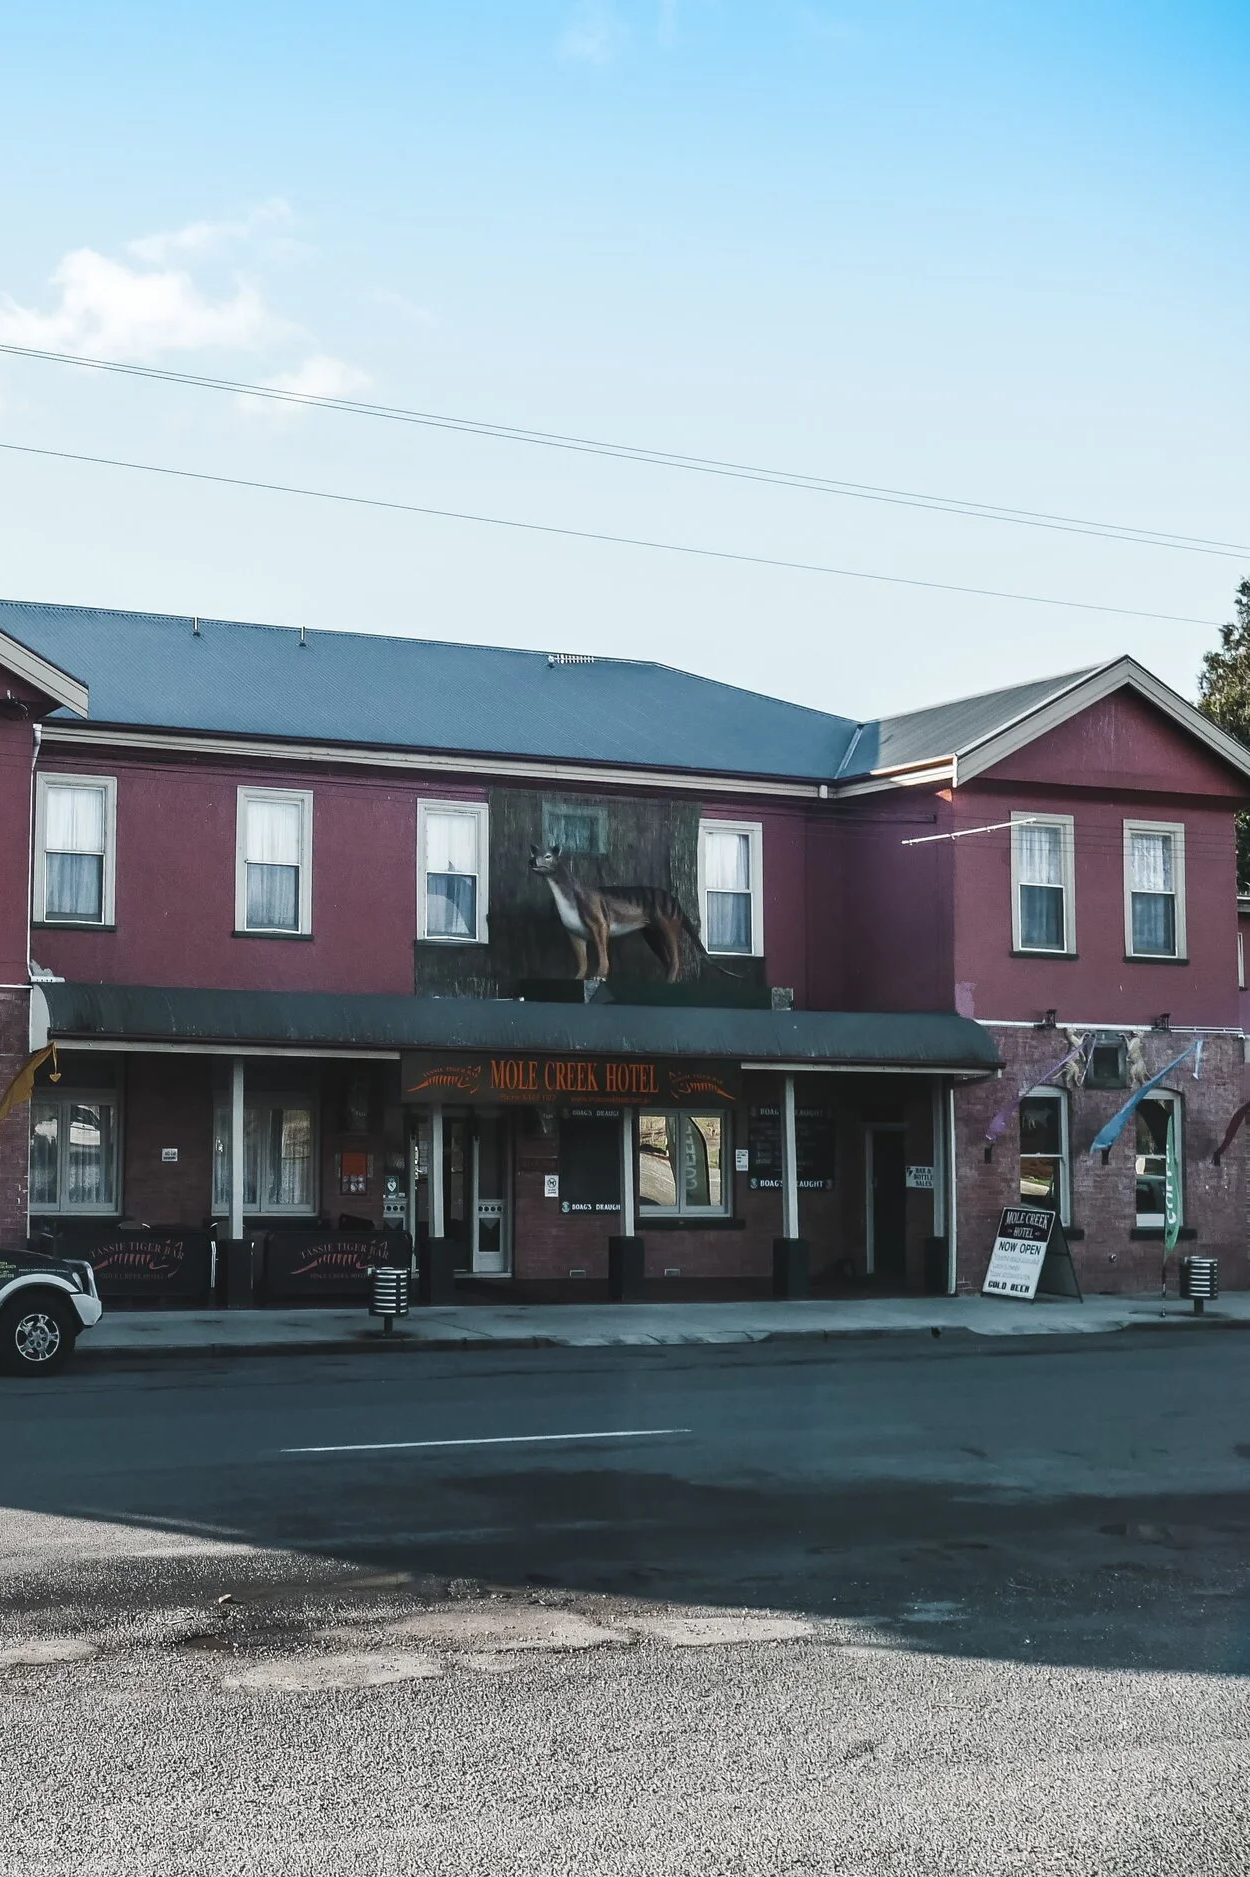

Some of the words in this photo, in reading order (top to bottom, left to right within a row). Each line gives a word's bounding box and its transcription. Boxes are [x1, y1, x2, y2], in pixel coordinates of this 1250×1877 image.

[490, 1060, 538, 1090] MOLE
[544, 1062, 599, 1092] CREEK
[605, 1063, 659, 1093] HOTEL
[797, 1180, 823, 1188] AUGHT
[1005, 1211, 1025, 1225] MOLE
[1025, 1213, 1049, 1230] CREEK
[1013, 1227, 1034, 1238] HOTEL
[999, 1241, 1018, 1252] NOW
[1020, 1243, 1041, 1255] OPEN
[988, 1280, 1007, 1290] COLD
[1010, 1283, 1030, 1293] BEER
